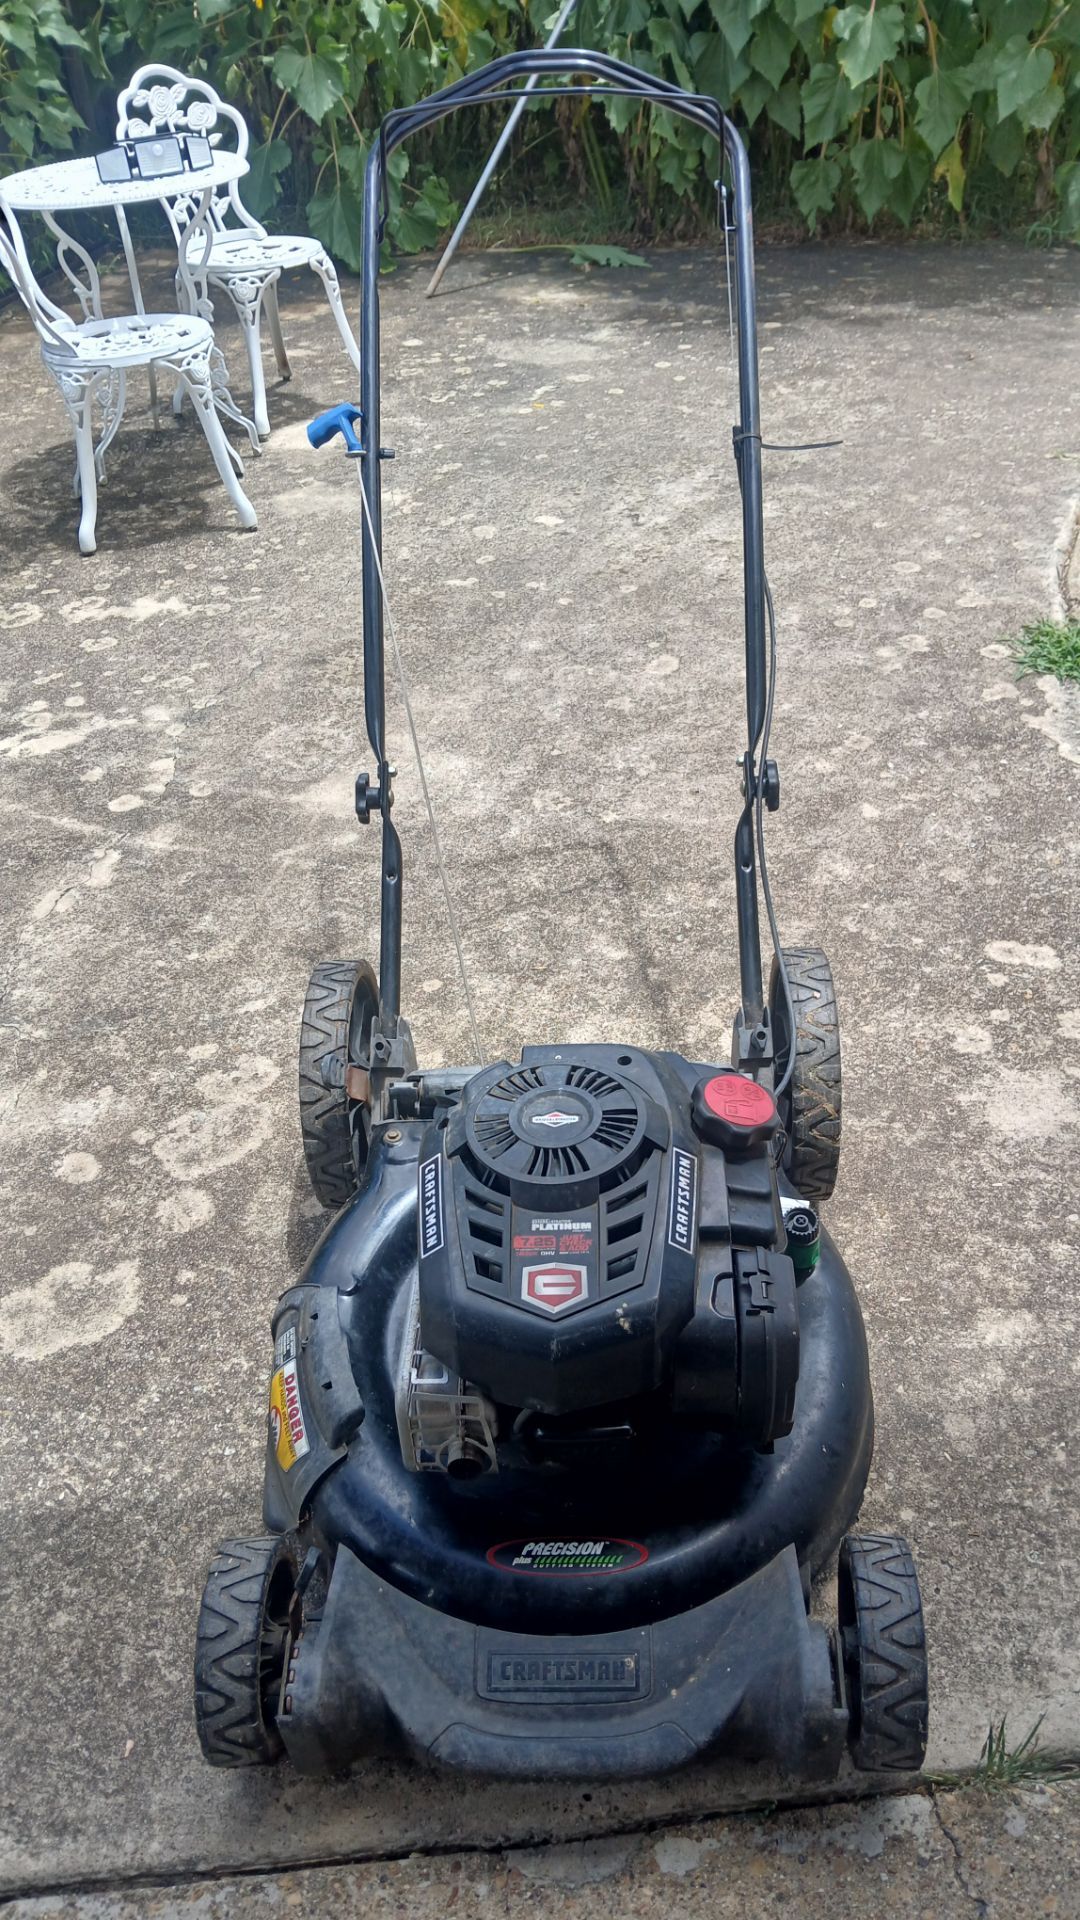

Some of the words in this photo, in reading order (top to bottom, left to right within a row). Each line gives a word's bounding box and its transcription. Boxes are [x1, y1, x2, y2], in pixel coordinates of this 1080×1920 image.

[424, 1163, 438, 1249] CRAFTSMAN
[675, 1156, 691, 1244] CRAFTSMAN
[531, 1222, 592, 1231] PLATINUM
[284, 1372, 304, 1445] DANGER
[512, 1556, 533, 1566] plus
[500, 1660, 626, 1681] CRAFTSMAN
